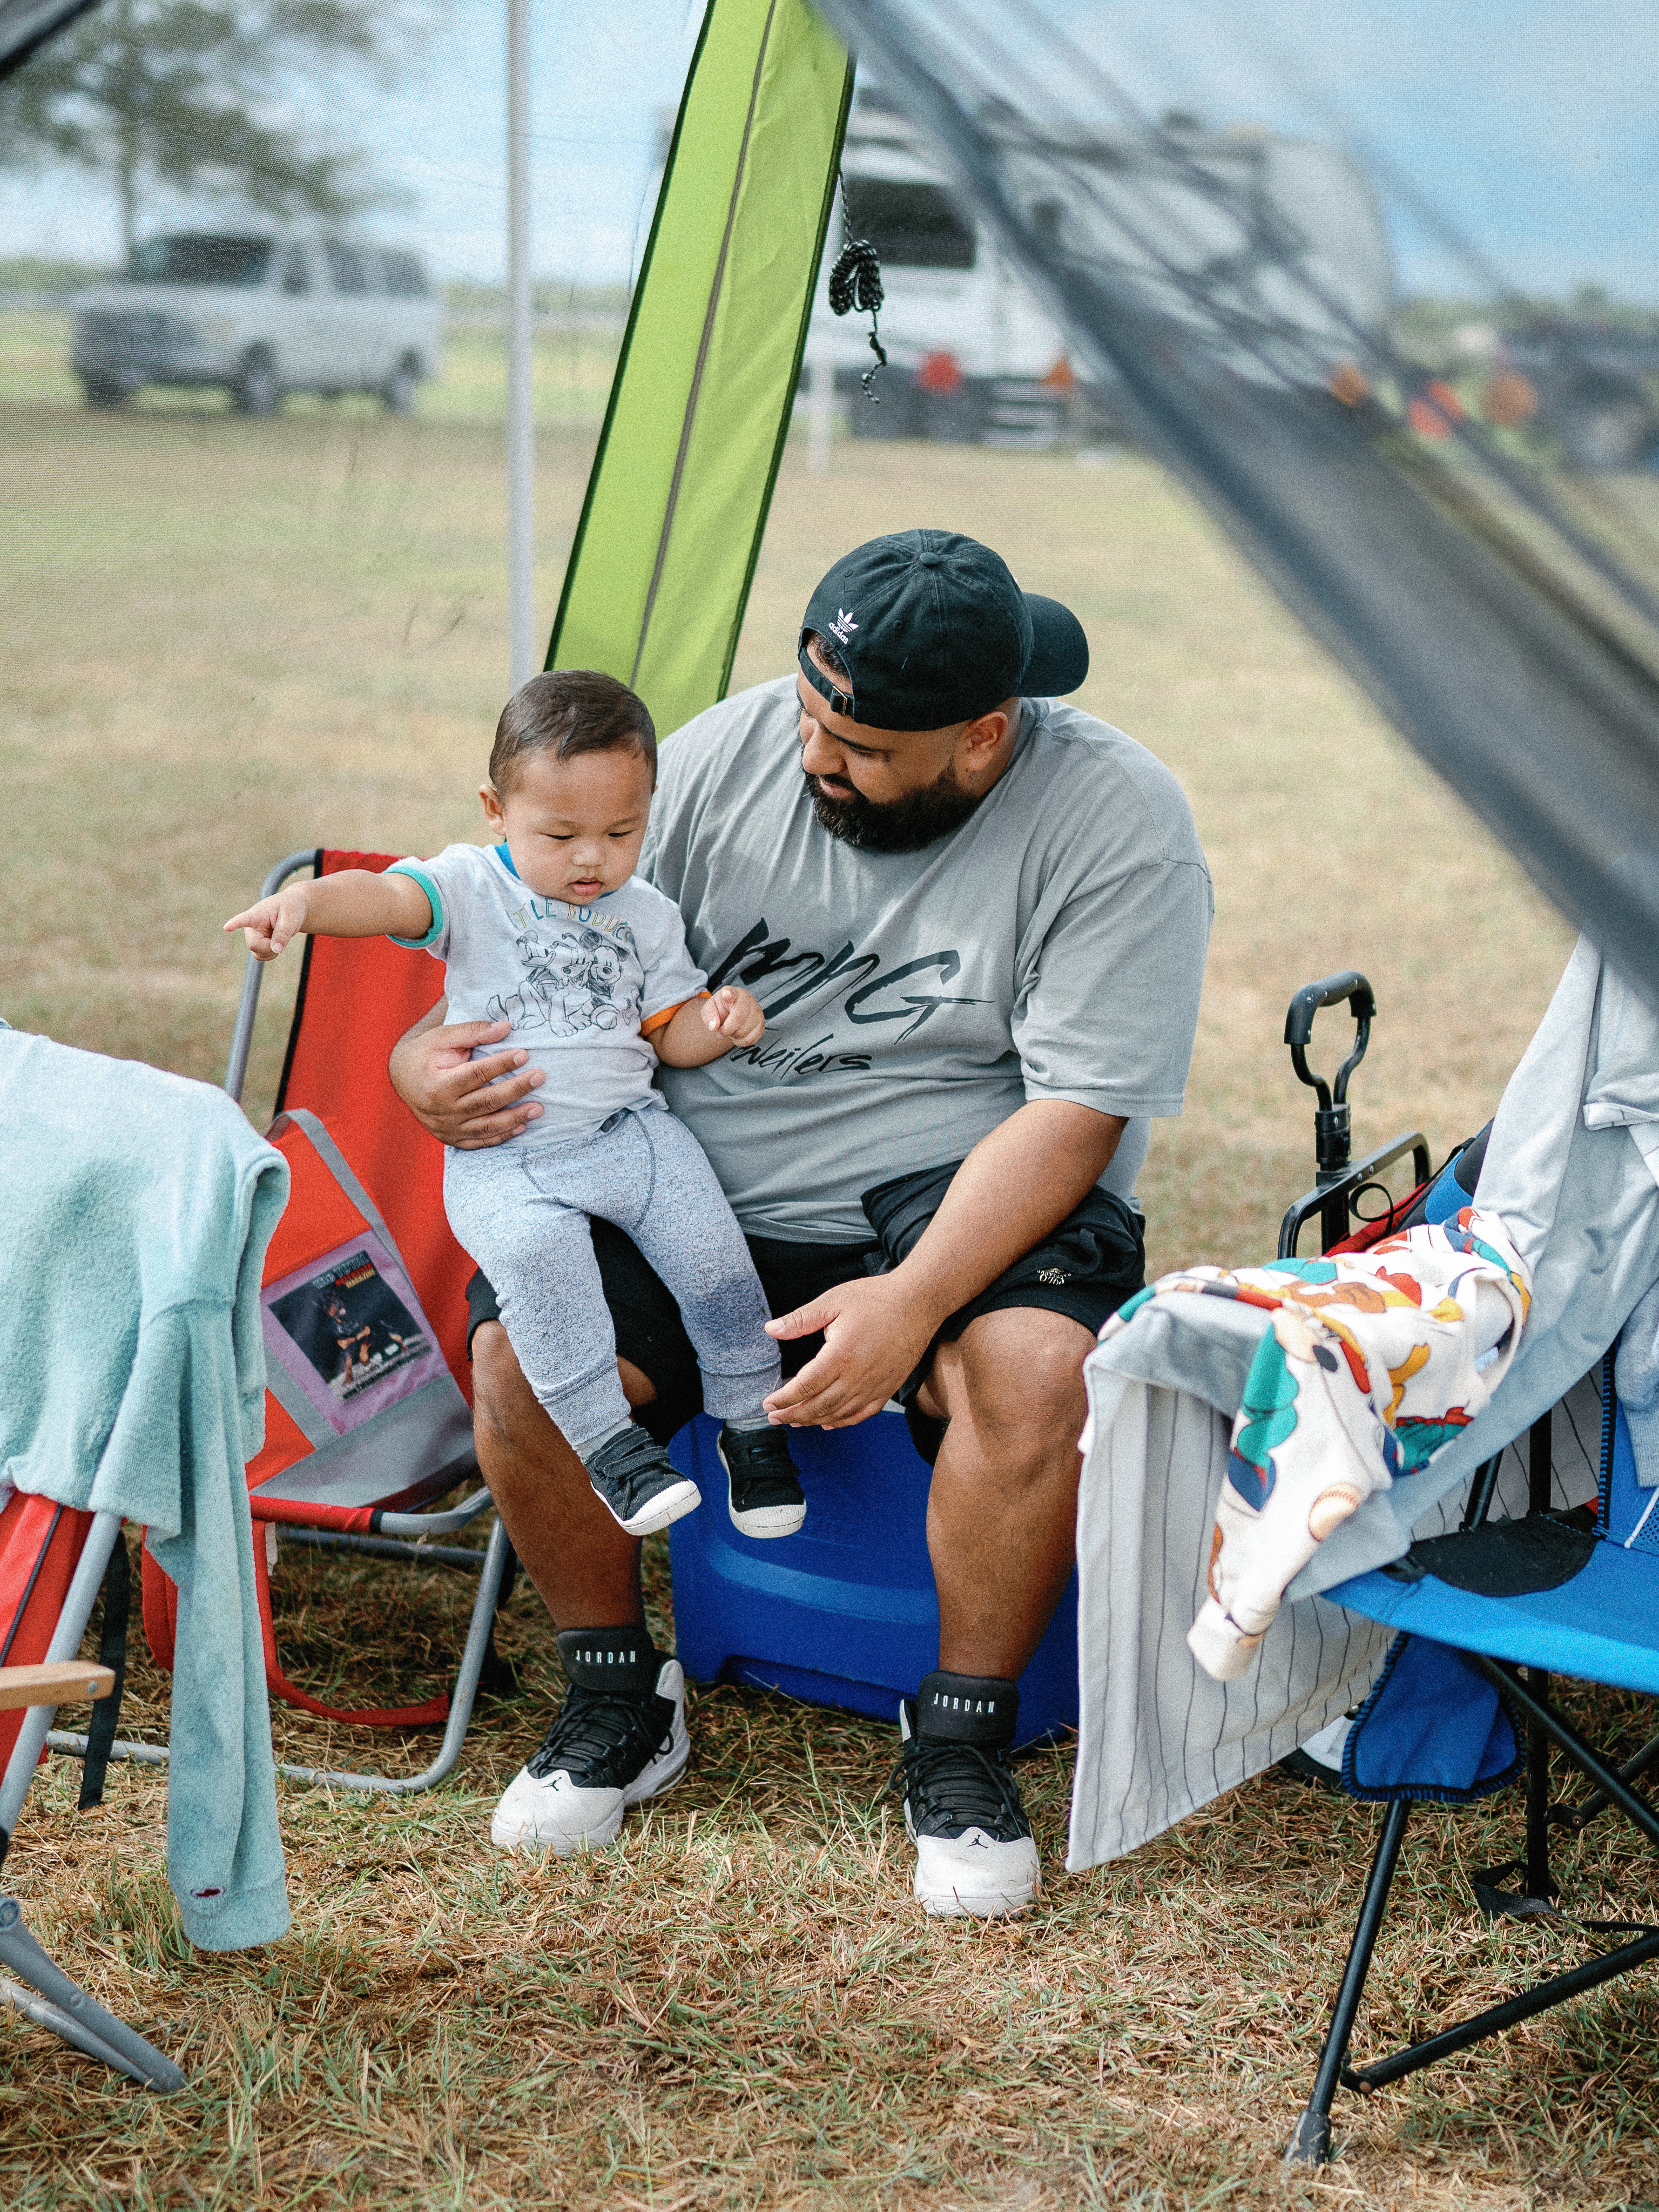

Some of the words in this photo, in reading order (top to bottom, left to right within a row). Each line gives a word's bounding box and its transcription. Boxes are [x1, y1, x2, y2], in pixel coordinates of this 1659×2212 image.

[828, 622, 849, 645] adidas
[575, 1650, 636, 1664] JORDAN
[933, 1692, 995, 1713] JORDAN
